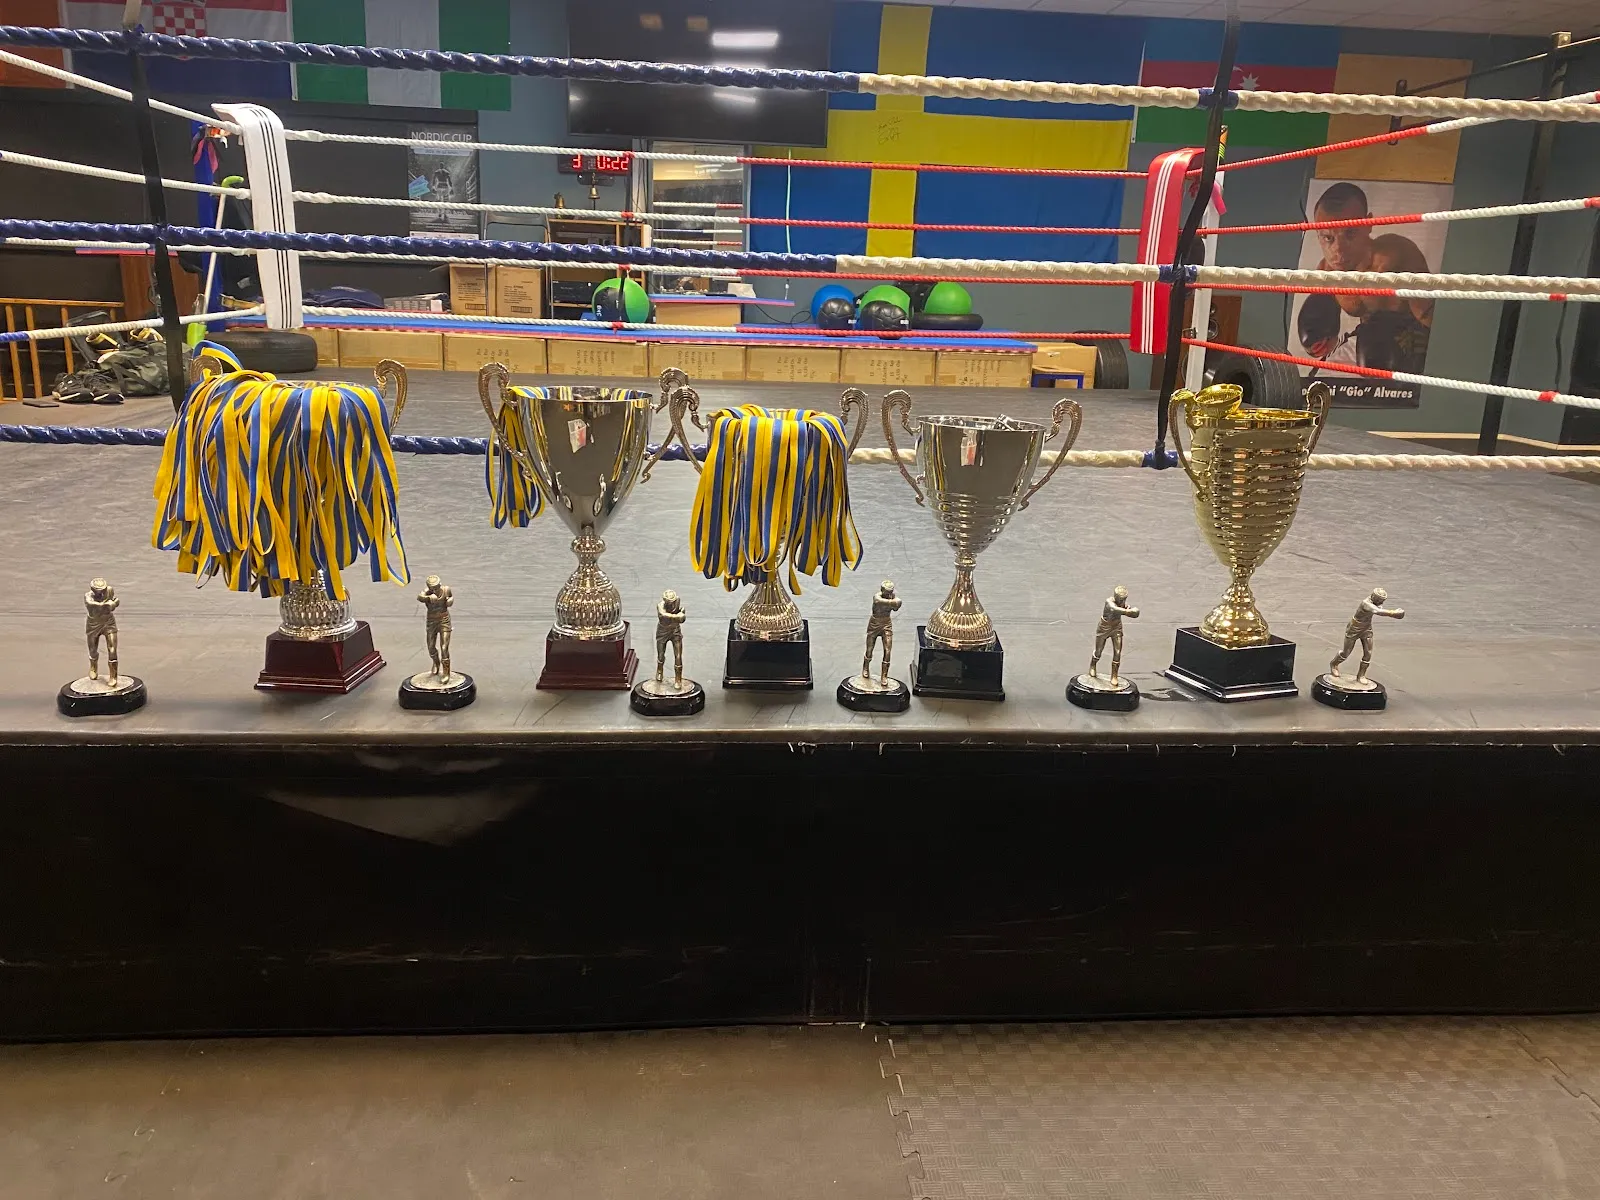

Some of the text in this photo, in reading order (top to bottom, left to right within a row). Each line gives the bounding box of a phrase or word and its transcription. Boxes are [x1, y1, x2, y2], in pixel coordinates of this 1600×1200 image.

[411, 131, 472, 142] NORDIC CUP
[597, 155, 629, 170] 0:22
[1374, 387, 1412, 398] Alvares
